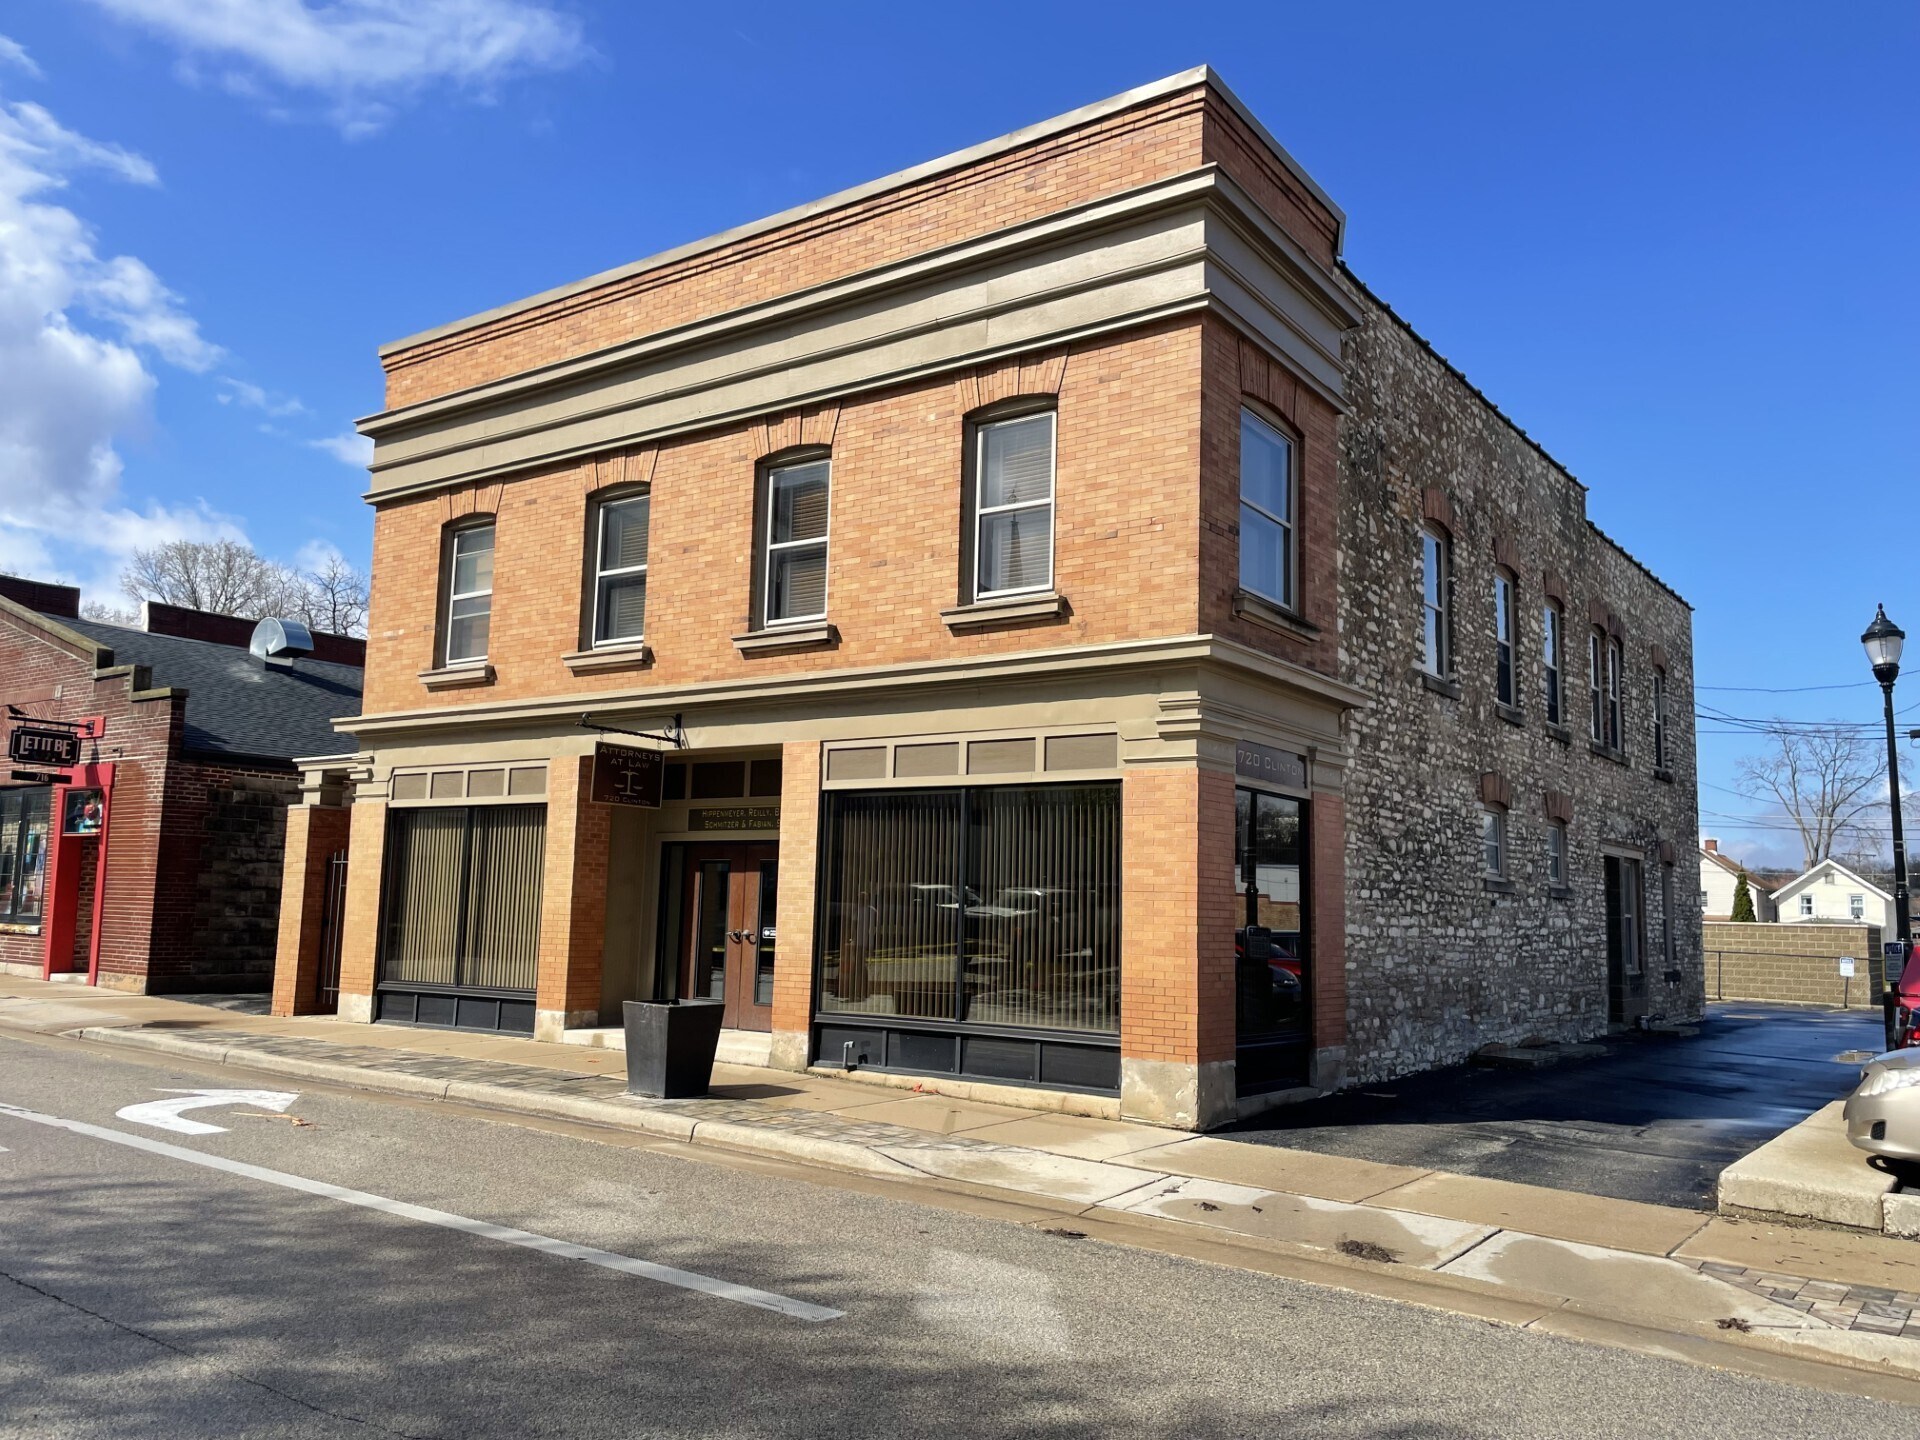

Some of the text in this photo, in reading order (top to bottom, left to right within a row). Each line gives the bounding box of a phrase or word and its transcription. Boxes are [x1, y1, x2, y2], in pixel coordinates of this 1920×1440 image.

[19, 735, 41, 755] LET
[41, 737, 54, 751] IT
[54, 739, 72, 759] BE
[600, 745, 660, 762] ATTORNEYS
[610, 758, 650, 769] AT LAW
[1237, 749, 1304, 777] 720 CLINTON
[36, 773, 49, 782] 716
[603, 794, 620, 802] 720
